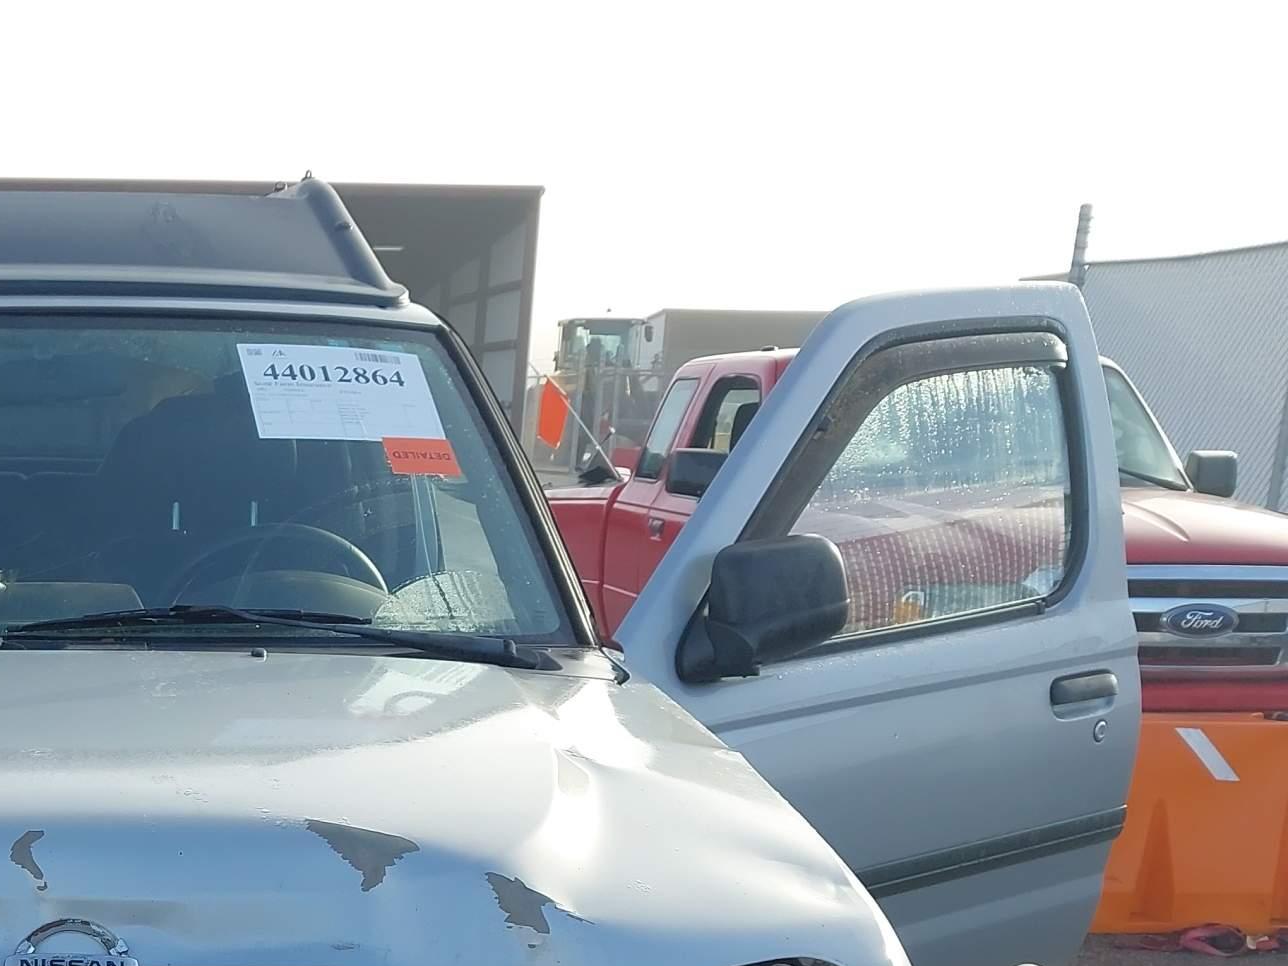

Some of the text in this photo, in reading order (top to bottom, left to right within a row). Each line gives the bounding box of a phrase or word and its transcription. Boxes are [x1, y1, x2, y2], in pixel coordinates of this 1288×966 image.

[263, 363, 405, 387] 44012864
[392, 450, 451, 461] DETAILED
[1180, 610, 1225, 629] Ford
